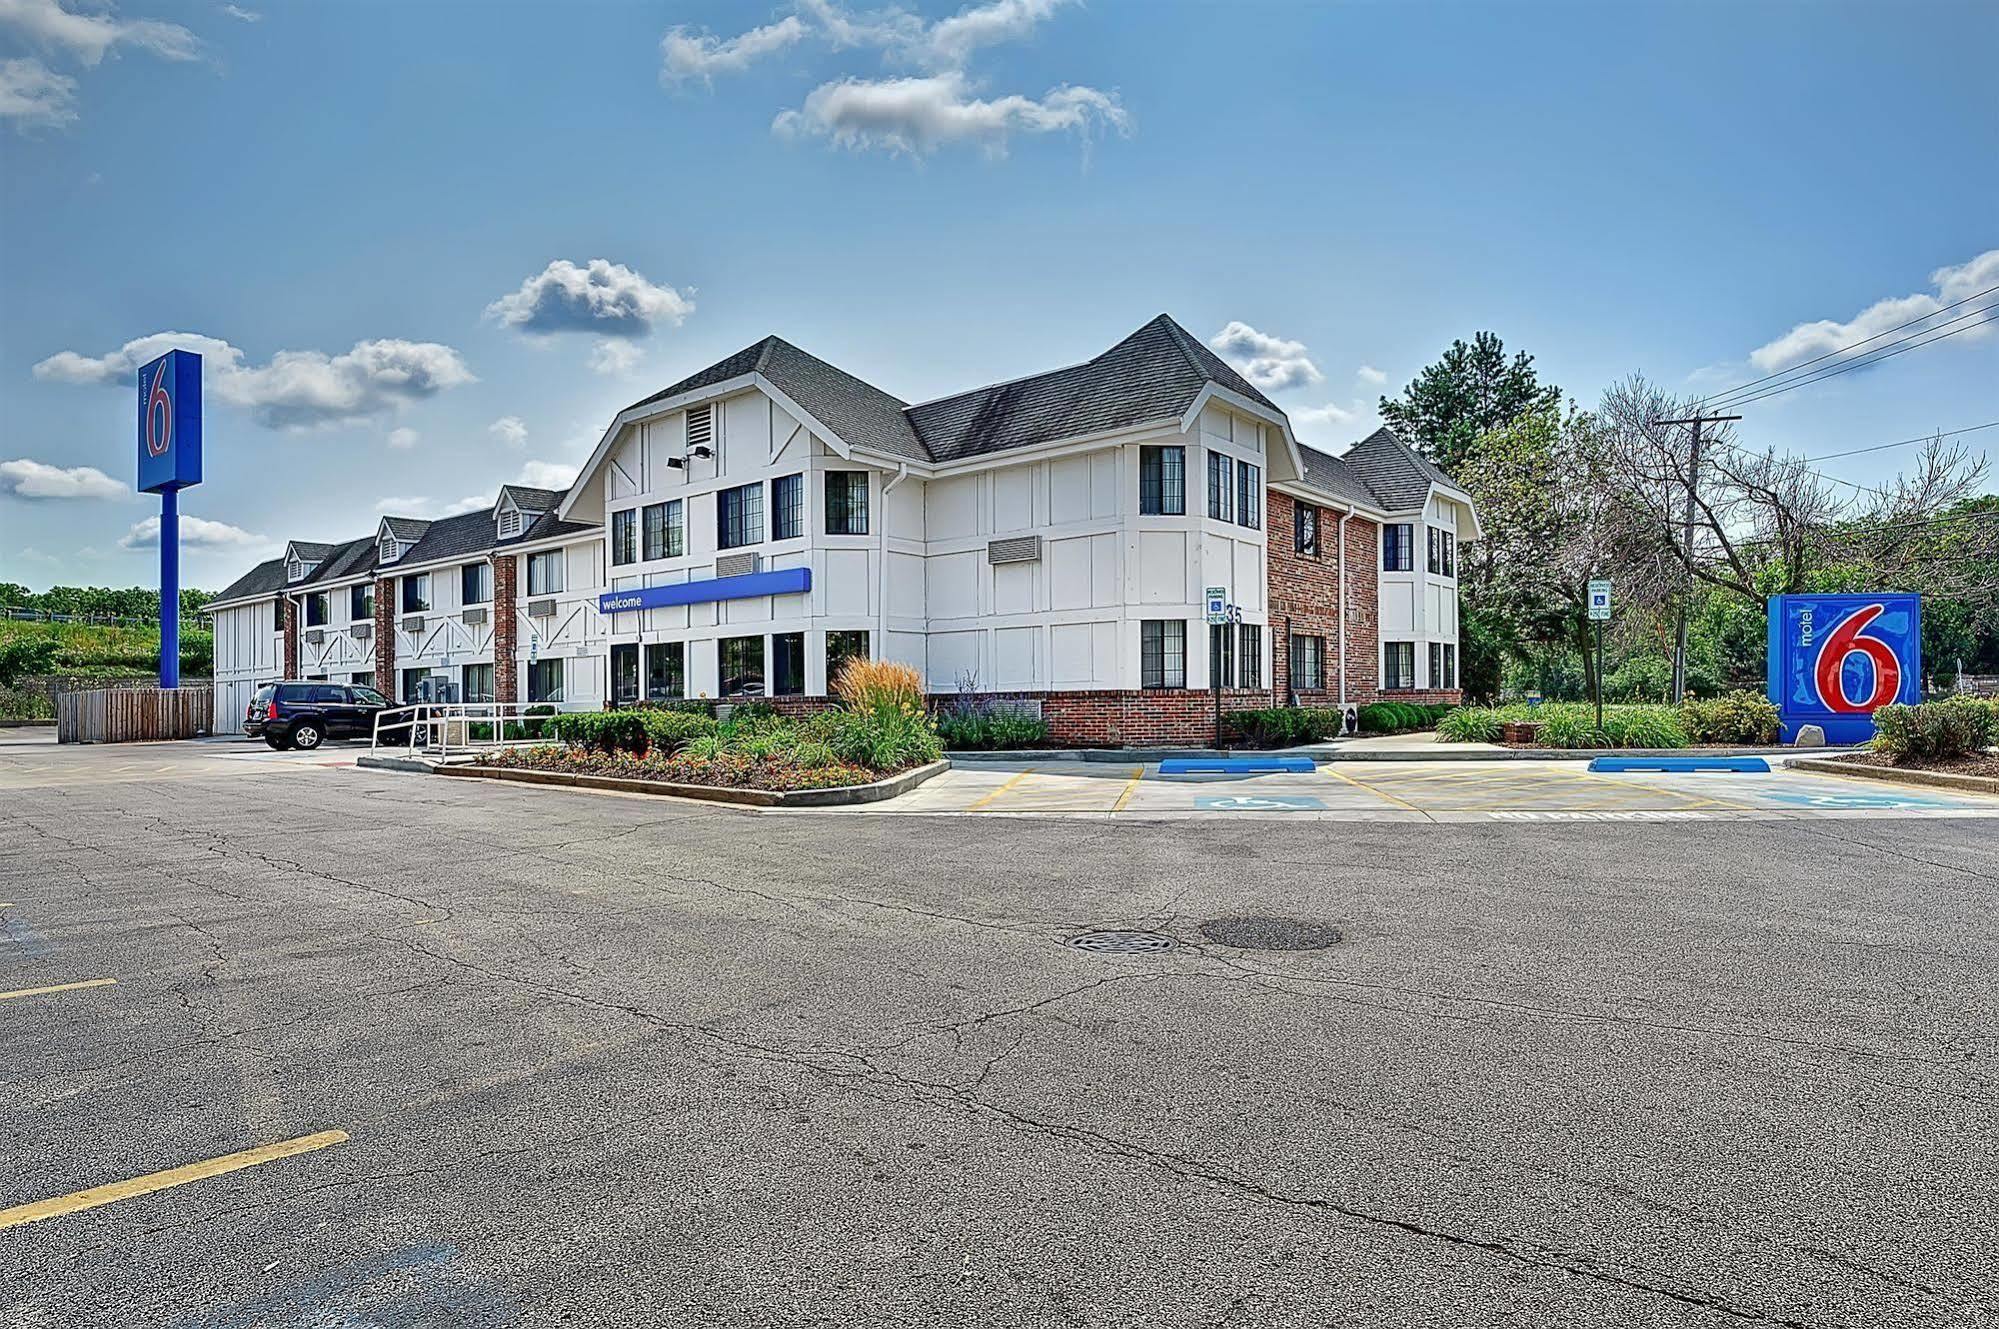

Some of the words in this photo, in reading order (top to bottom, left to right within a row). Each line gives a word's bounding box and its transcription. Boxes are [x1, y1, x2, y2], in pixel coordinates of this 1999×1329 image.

[146, 359, 171, 457] 6
[602, 596, 643, 610] welcome
[1799, 609, 1813, 647] motel
[1814, 603, 1901, 714] 6
